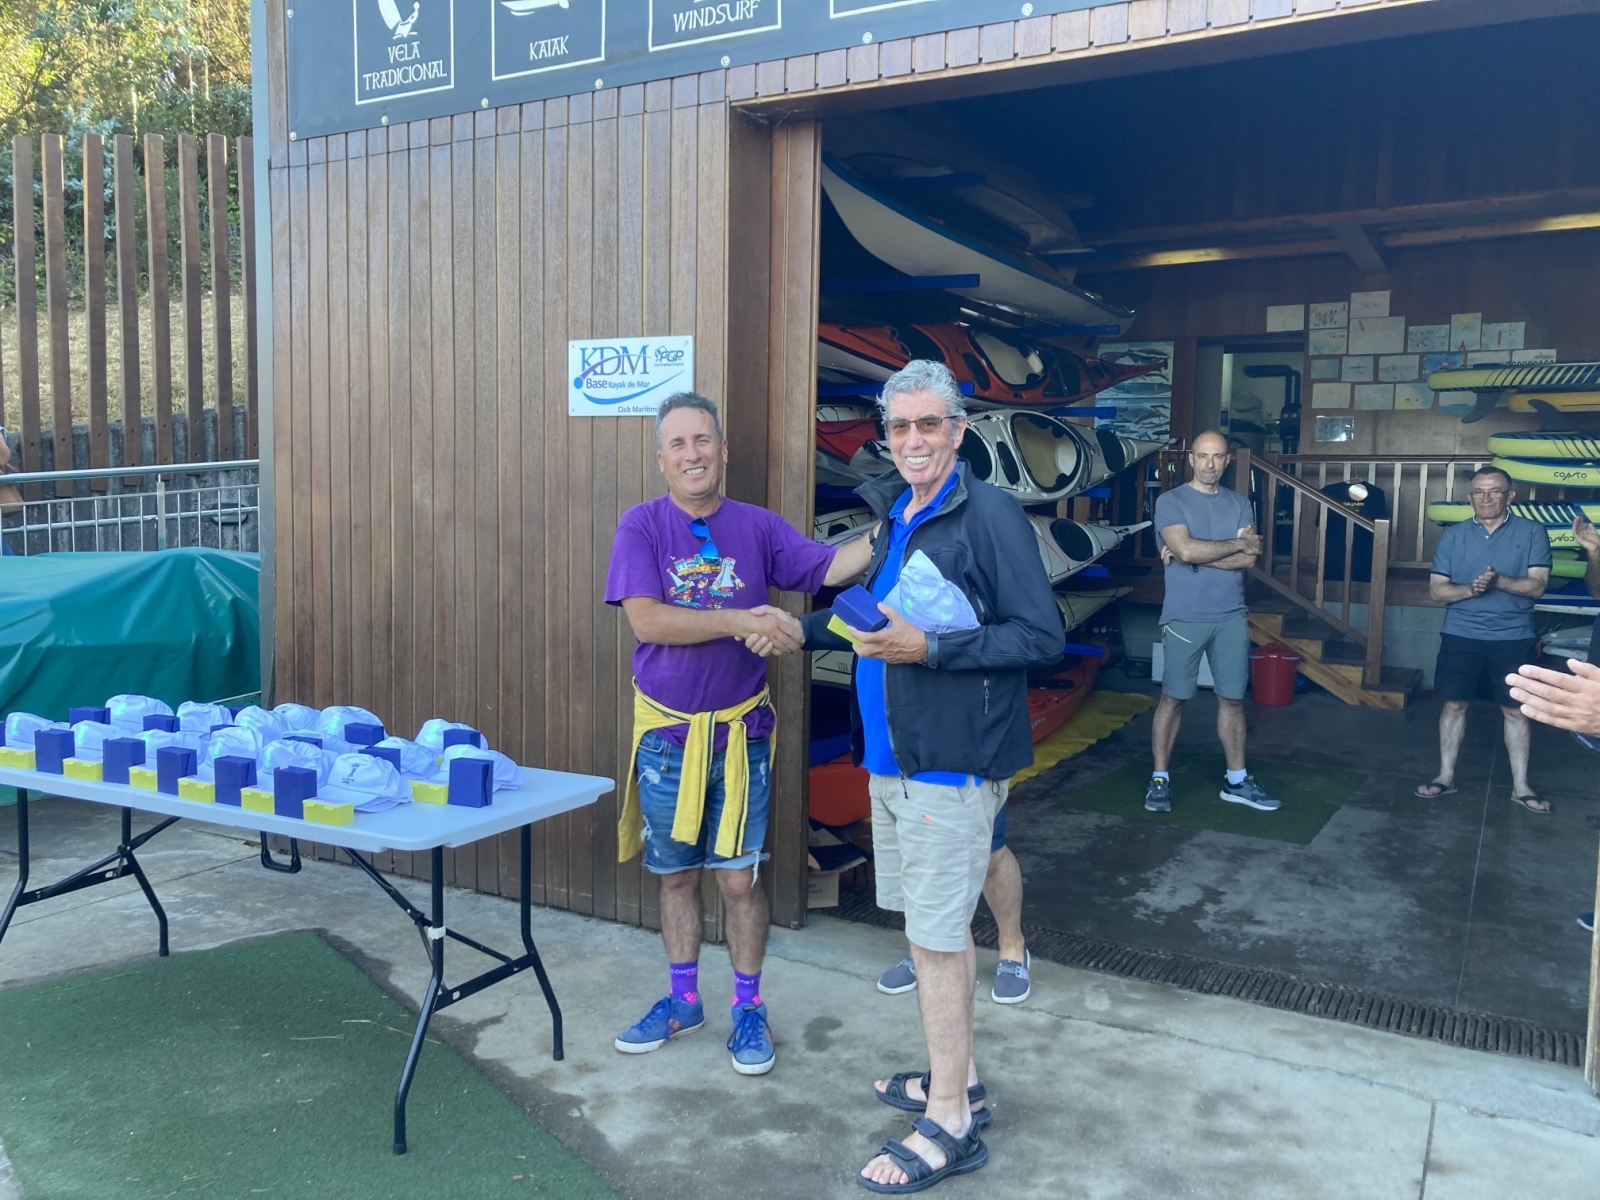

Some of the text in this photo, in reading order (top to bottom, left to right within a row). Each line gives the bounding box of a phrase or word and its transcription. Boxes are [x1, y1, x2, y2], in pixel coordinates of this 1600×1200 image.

[673, 0, 759, 32] WINDSURF
[387, 41, 421, 63] VELA
[529, 35, 569, 60] KAIAK
[362, 60, 447, 91] TRADICIONAL
[579, 345, 650, 376] KDM
[586, 378, 608, 389] Base
[608, 381, 626, 390] Kayak
[636, 380, 650, 388] Mar
